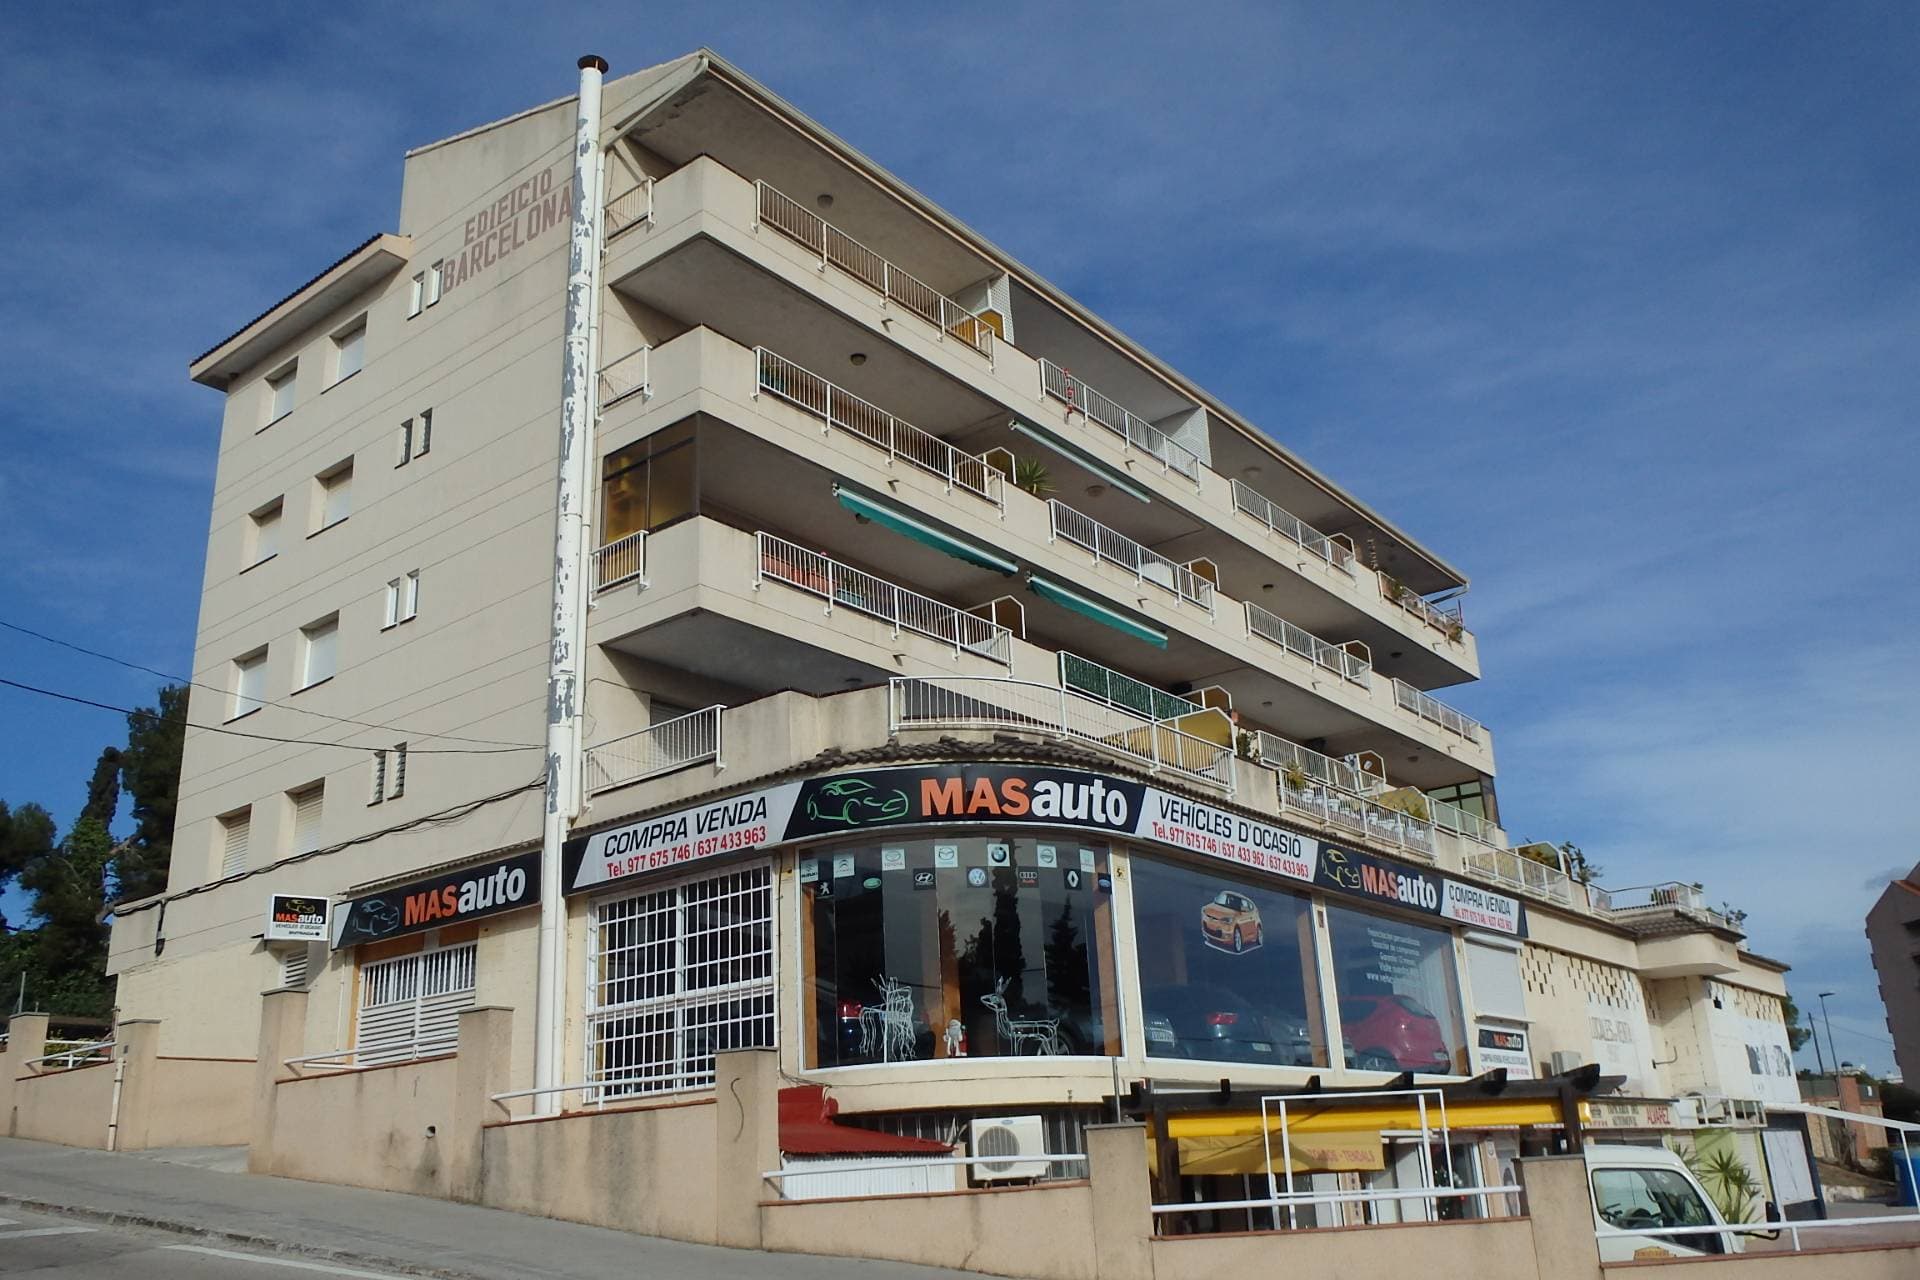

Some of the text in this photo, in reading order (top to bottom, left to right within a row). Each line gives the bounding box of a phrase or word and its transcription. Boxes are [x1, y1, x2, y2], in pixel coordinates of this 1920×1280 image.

[463, 168, 553, 247] EDIFICIO
[443, 186, 573, 294] BARCELONA
[604, 797, 767, 857] COMPRA VENDA
[920, 777, 1128, 826] MASauto
[1159, 796, 1301, 858] VEHÍCLES D'OCASIÓ
[607, 861, 625, 877] Tel.
[628, 855, 646, 873] 977
[650, 848, 668, 868] 675
[672, 844, 690, 863] 746
[697, 837, 719, 856] 637
[720, 831, 742, 850] 433
[744, 826, 766, 845] 963
[1152, 821, 1169, 840] Tel.
[1170, 827, 1185, 844] 977
[1186, 832, 1201, 848] 675
[1202, 836, 1217, 853] 746
[1222, 842, 1235, 859] 637
[1238, 846, 1250, 863] 433
[1252, 850, 1265, 867] 962
[1269, 855, 1281, 871] 637
[1283, 860, 1296, 875] 433
[1296, 863, 1309, 878] 963
[404, 864, 526, 926] MASauto
[1361, 863, 1437, 910] MASauto
[1449, 884, 1511, 916] COMPRA VENDA
[275, 912, 324, 924] MASauto
